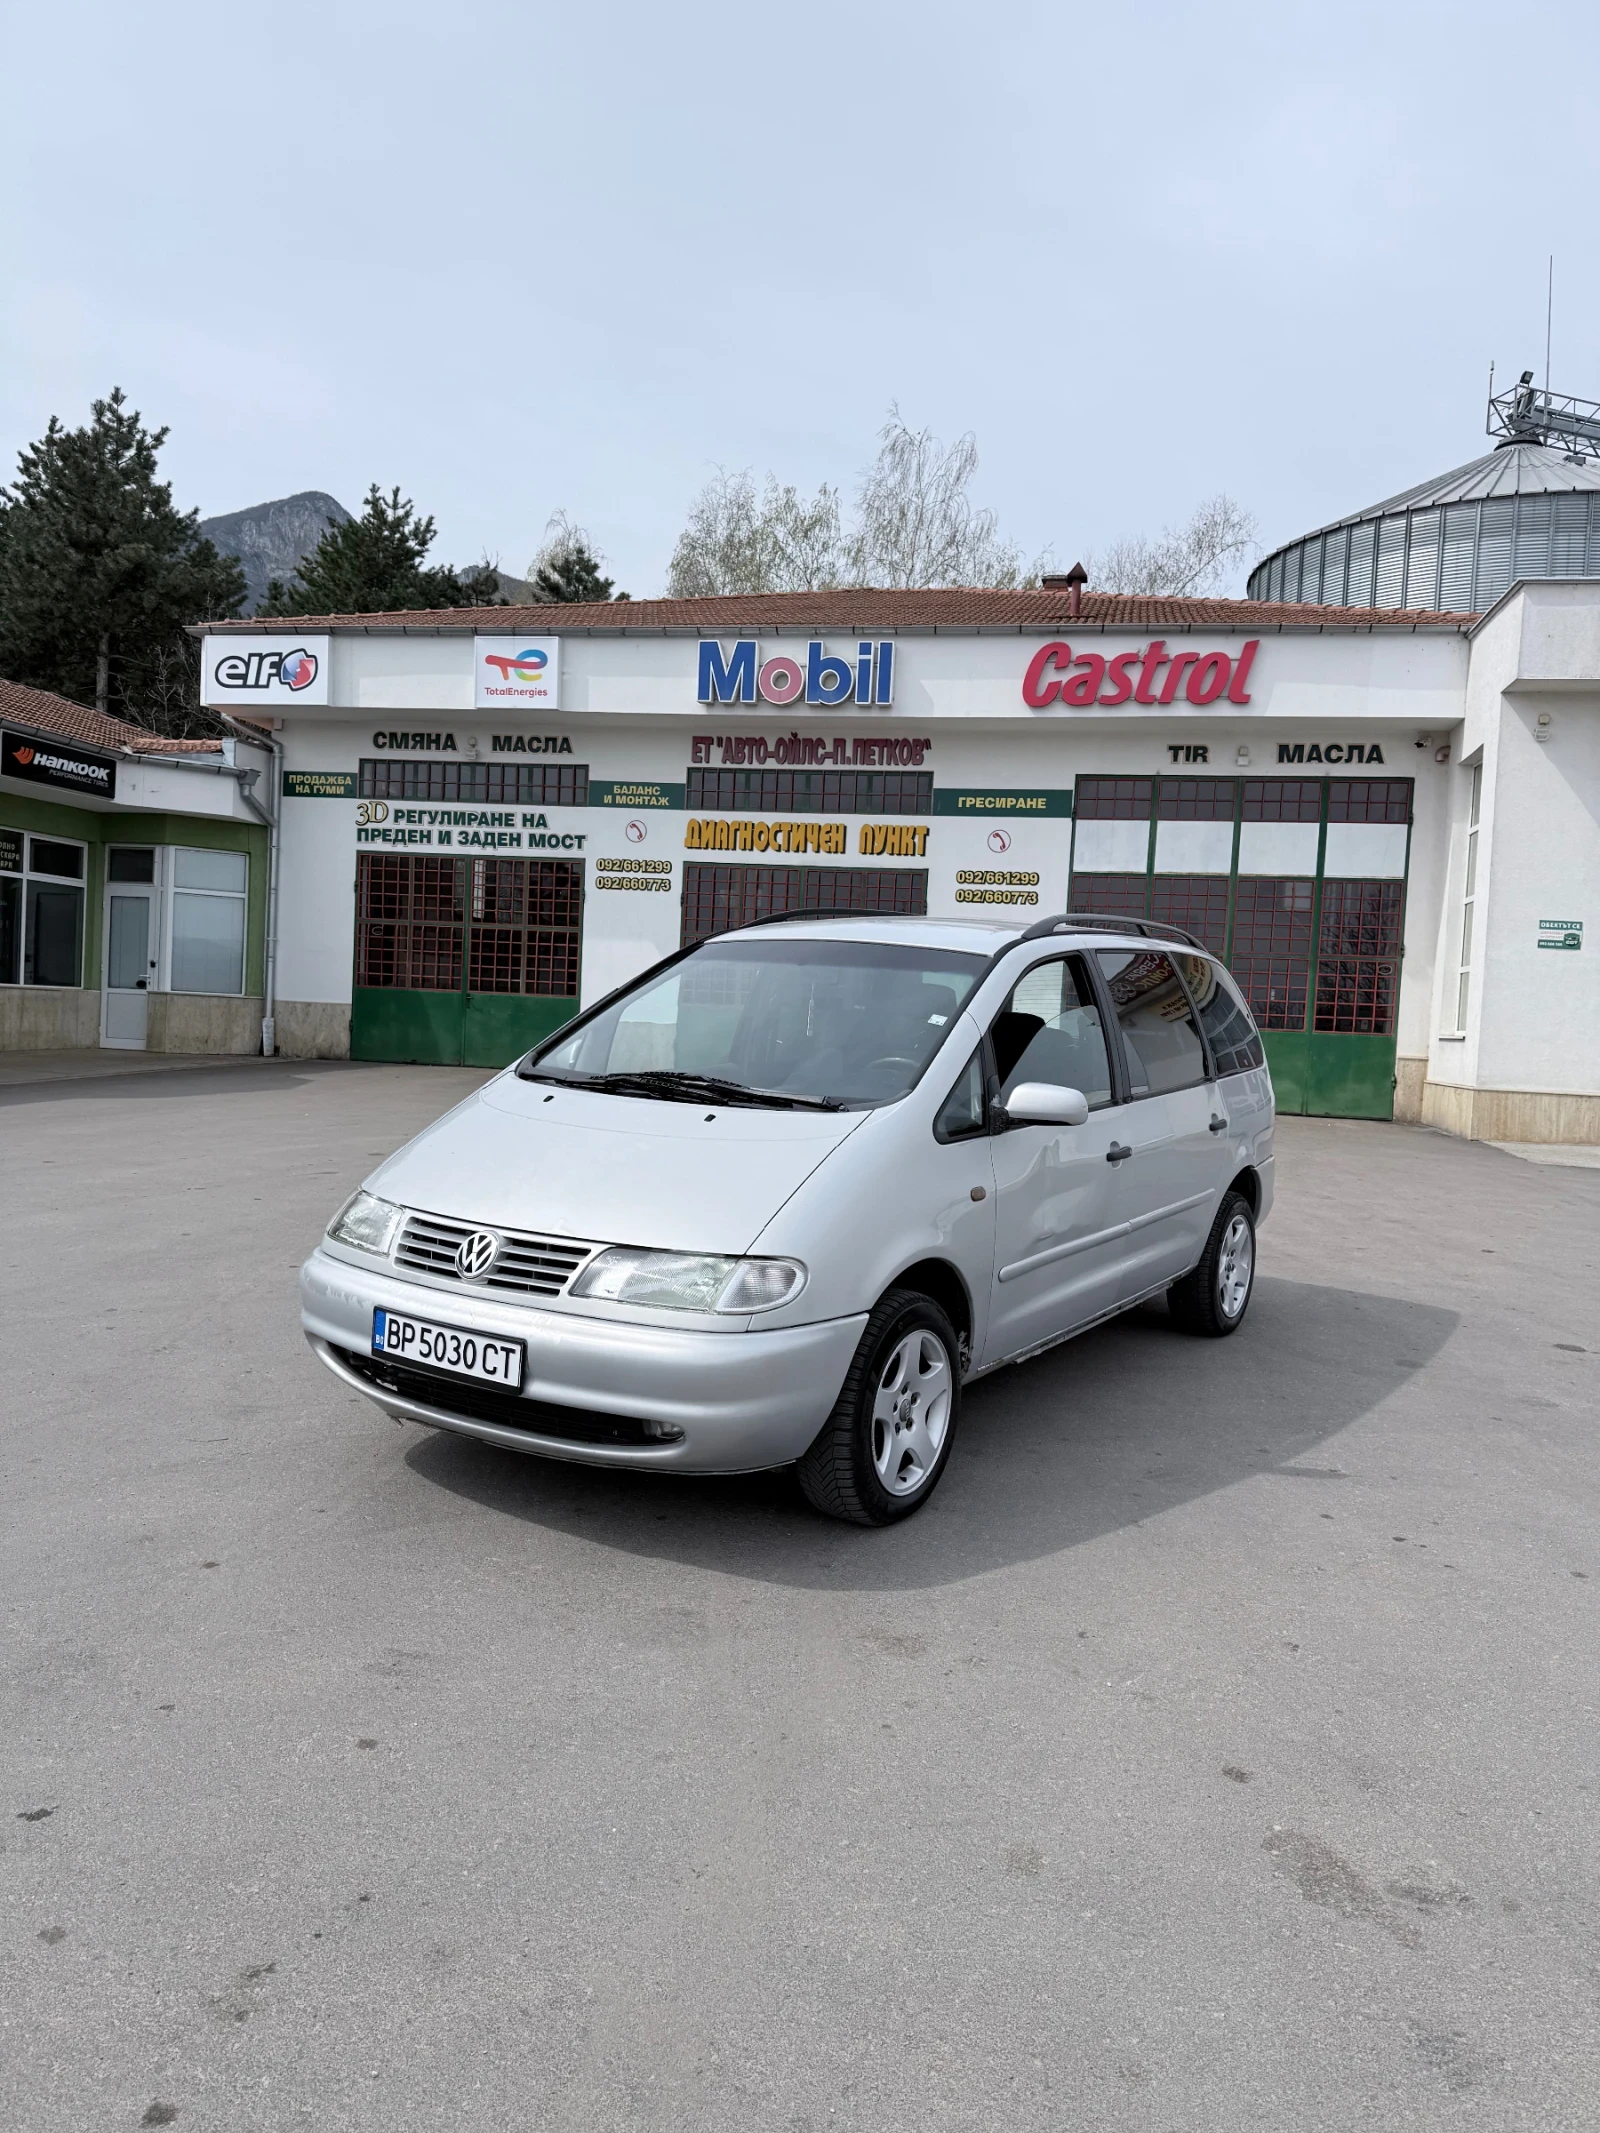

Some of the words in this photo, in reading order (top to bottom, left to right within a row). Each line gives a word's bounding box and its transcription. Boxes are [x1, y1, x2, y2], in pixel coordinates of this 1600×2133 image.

[214, 651, 283, 690] elf
[697, 640, 896, 706] Mobil
[1022, 639, 1260, 707] Castrol
[485, 687, 548, 699] TotalEnergies
[373, 731, 458, 751] СМЯНА
[491, 735, 573, 754] МАСЛА
[692, 736, 714, 764] ЕТ
[1168, 745, 1210, 763] TIR
[1277, 744, 1385, 764] МАСЛА
[288, 774, 352, 786] ПРОДАЖБА
[295, 784, 312, 794] НА
[313, 785, 345, 796] ГУМИ
[613, 785, 661, 796] БАЛАНС
[603, 795, 612, 805] И
[615, 795, 670, 806] МОНТАЖ
[957, 796, 1047, 810] ГРЕСИРАНЕ
[355, 801, 389, 827] 3D
[393, 808, 518, 829] РЕГУЛИРАНЕ
[521, 813, 549, 829] НА
[356, 827, 433, 846] ПРЕДЕН
[437, 830, 453, 846] И
[457, 830, 522, 849] ЗАДЕН
[527, 834, 588, 851] МОСТ
[684, 818, 848, 855] ДИАГНОСТИЧЕН
[858, 823, 931, 857] ПУНКТ
[596, 858, 672, 874] 092/661299
[595, 875, 671, 891] 092/660773
[955, 870, 1039, 887] 092/661299
[955, 888, 1038, 905] 092/660773
[419, 1326, 477, 1369] 5030
